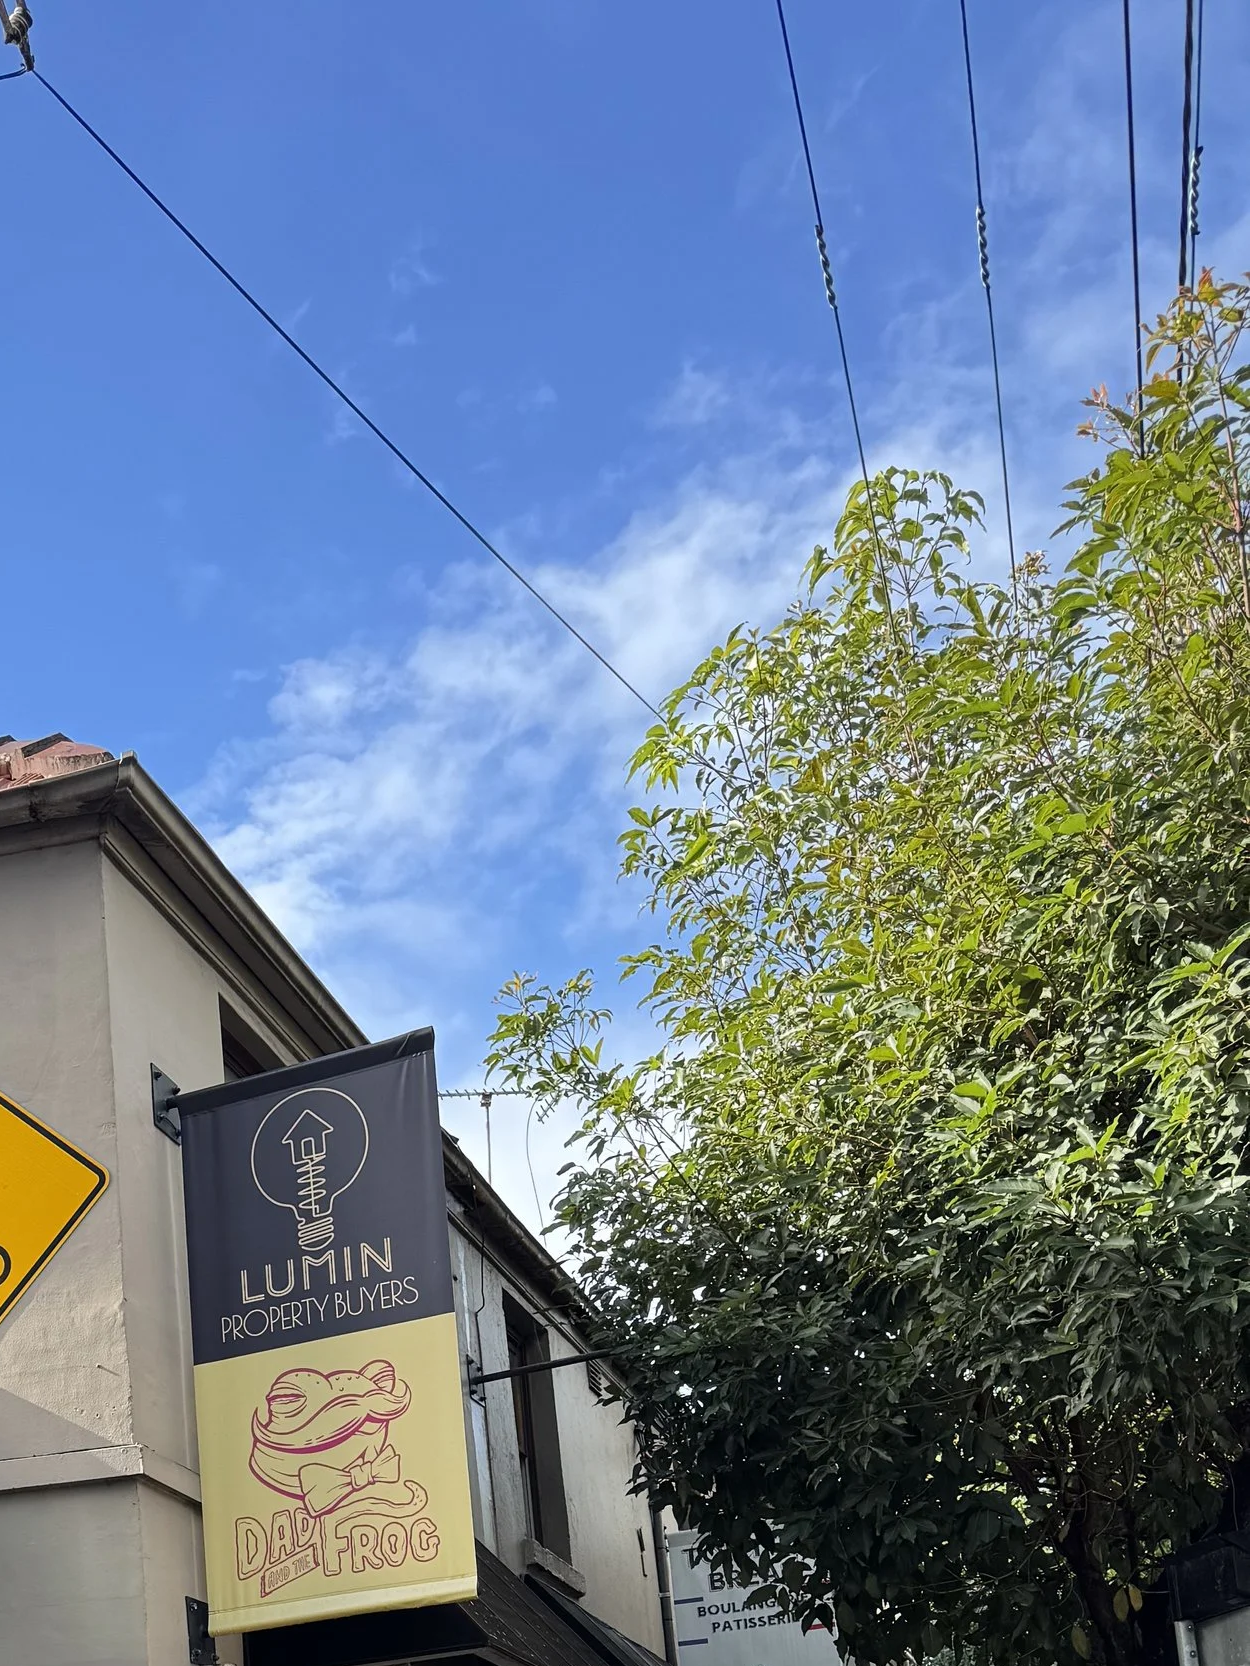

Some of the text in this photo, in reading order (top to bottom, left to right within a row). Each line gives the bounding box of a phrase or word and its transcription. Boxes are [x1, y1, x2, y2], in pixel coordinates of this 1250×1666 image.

[241, 1237, 392, 1304] LUMIN
[221, 1276, 419, 1343] PROPERTY BUYERS
[235, 1480, 440, 1581] DAD FROG
